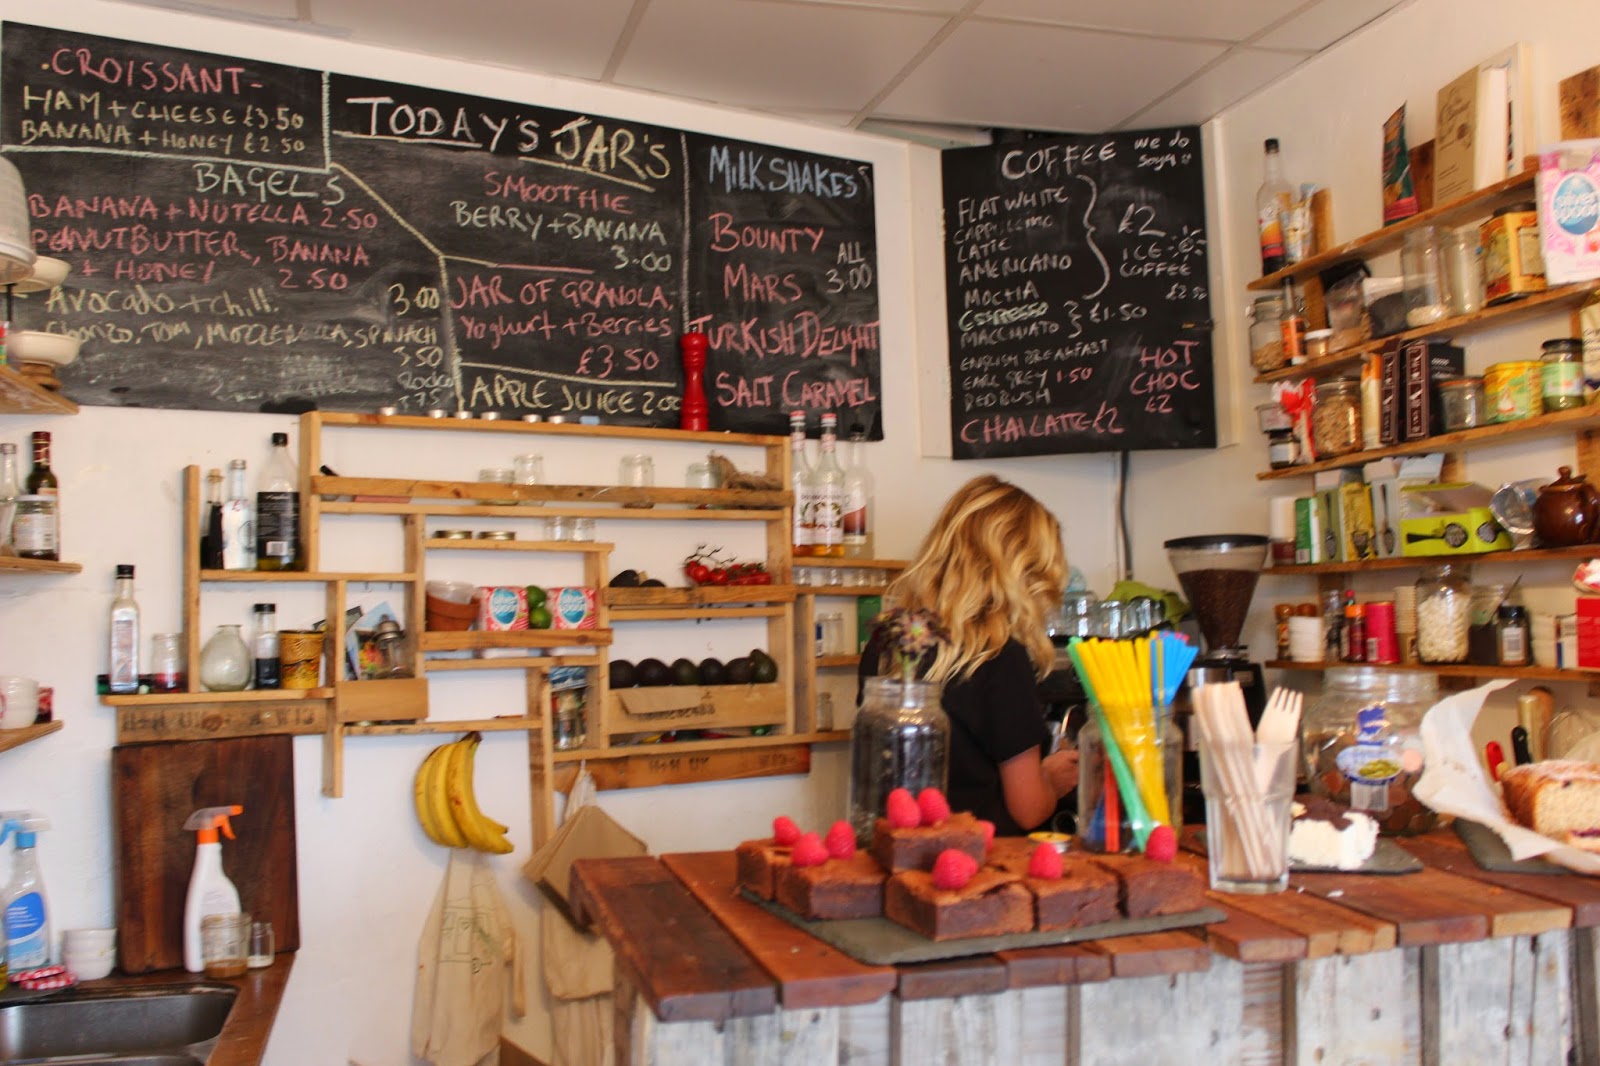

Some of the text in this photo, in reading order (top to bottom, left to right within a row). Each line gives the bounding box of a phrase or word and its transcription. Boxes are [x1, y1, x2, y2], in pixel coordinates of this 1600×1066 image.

[23, 85, 100, 120] HAM
[131, 101, 236, 125] CHEESE
[243, 104, 304, 131] £3.50
[22, 119, 132, 146] BANANA
[162, 130, 234, 155] HONEY
[243, 132, 306, 154] £2.50
[346, 97, 671, 181] TODAY'S JAR'S
[1169, 130, 1190, 148] do
[1001, 141, 1117, 181] COFFEE
[192, 162, 346, 206] BAGELS
[483, 171, 634, 215] SMOOTHIE
[28, 194, 158, 220] BANANA
[188, 196, 310, 227] NUTELLA
[320, 207, 379, 231] 2.50
[449, 200, 546, 242] BERRY
[958, 186, 1069, 228] FLAT WHITE
[708, 212, 825, 254] BOUNTY
[957, 237, 1012, 263] LATTE
[265, 235, 370, 266] BANANA
[611, 244, 672, 272] 3.00
[837, 242, 866, 265] ALL
[114, 259, 216, 285] HONEY
[279, 267, 349, 291] 2.50
[723, 263, 803, 305] MARS
[825, 264, 872, 294] 3.00
[959, 252, 1073, 286] AMERICANO
[1119, 261, 1192, 278] COFFEE
[450, 275, 514, 309] JAR
[520, 278, 557, 305] OF
[964, 280, 1040, 309] MOCHA
[460, 310, 557, 350] Yoghurt
[689, 314, 796, 360] TURKISH
[961, 321, 1060, 349] MACCHIATO
[1138, 340, 1200, 368] HOT
[470, 374, 553, 409] APPLE
[561, 384, 636, 415] JUICE
[716, 370, 775, 408] SALT
[1005, 368, 1049, 390] GREY
[1129, 369, 1201, 395] CHOC
